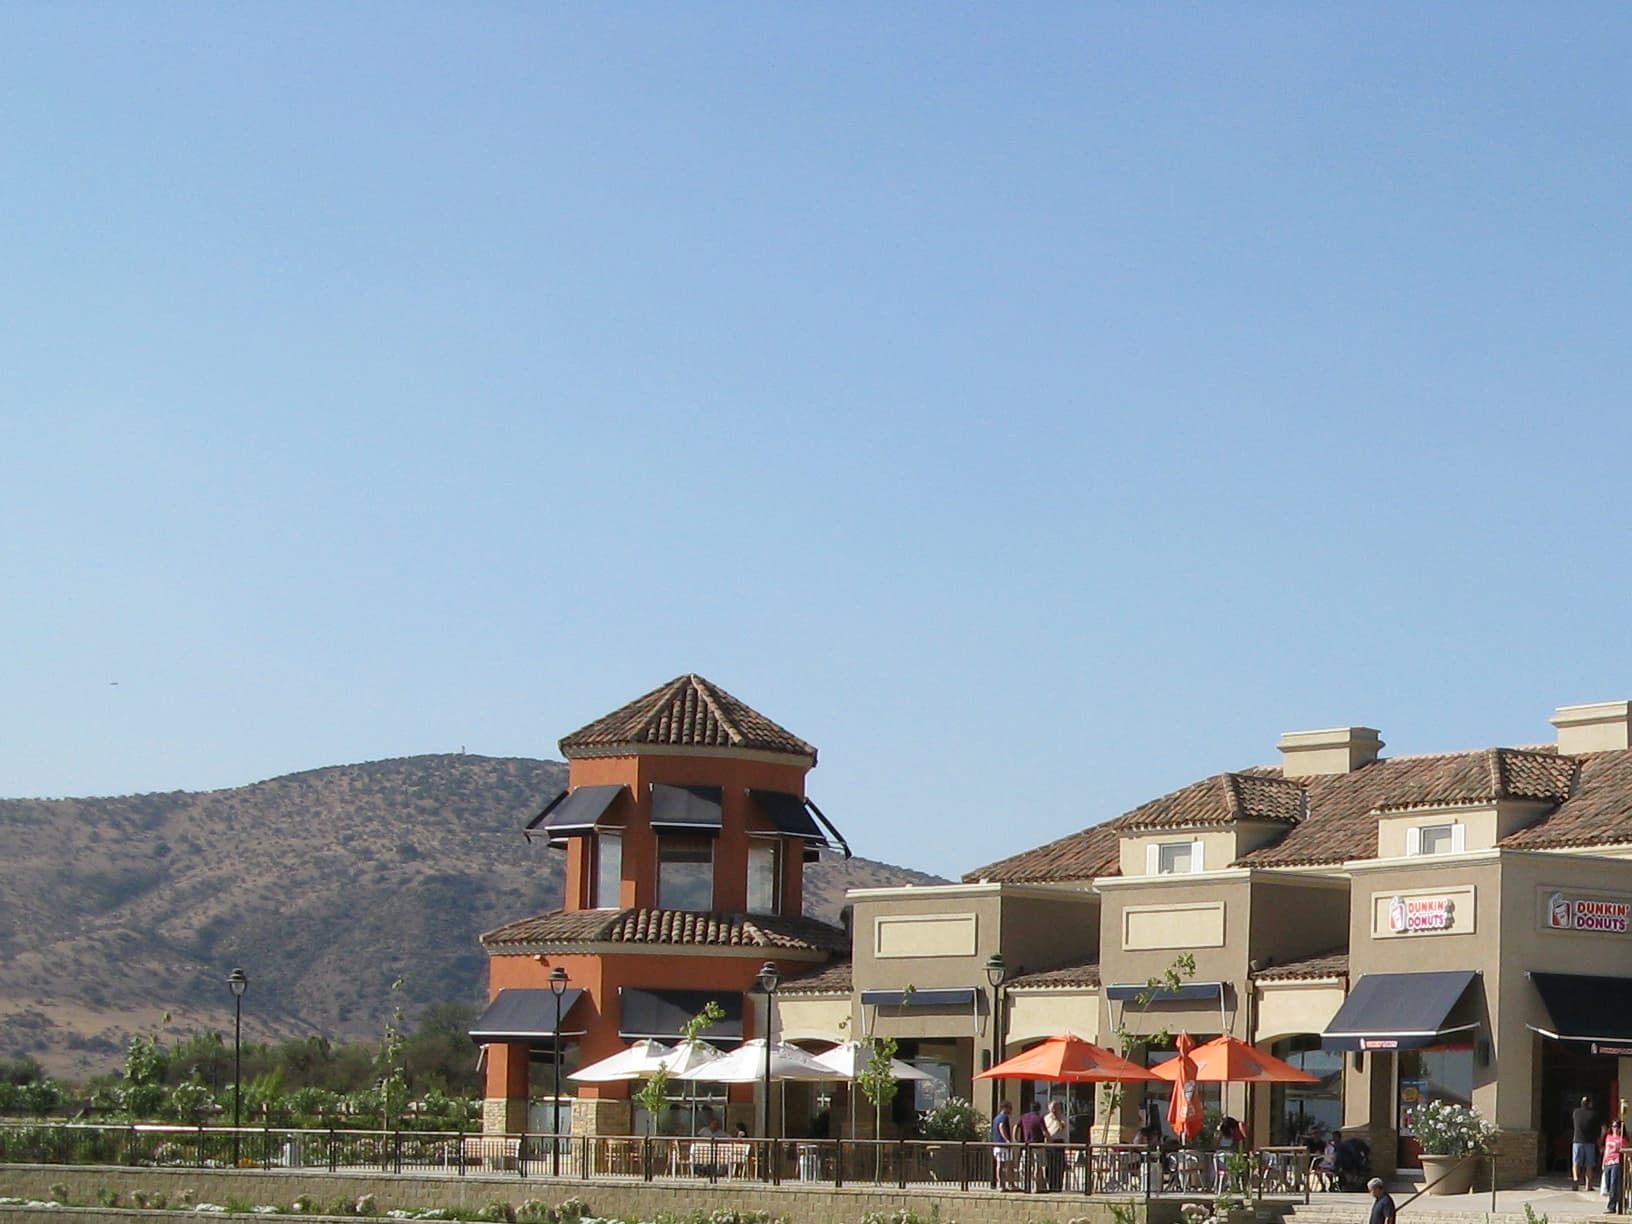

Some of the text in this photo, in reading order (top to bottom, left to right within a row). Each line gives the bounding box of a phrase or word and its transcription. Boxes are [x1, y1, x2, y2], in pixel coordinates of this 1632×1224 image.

[1408, 900, 1447, 913] DUNKIN'
[1577, 902, 1630, 916] DUNKIN'
[1408, 914, 1444, 927] DONUTS
[1576, 916, 1627, 931] DONUTS
